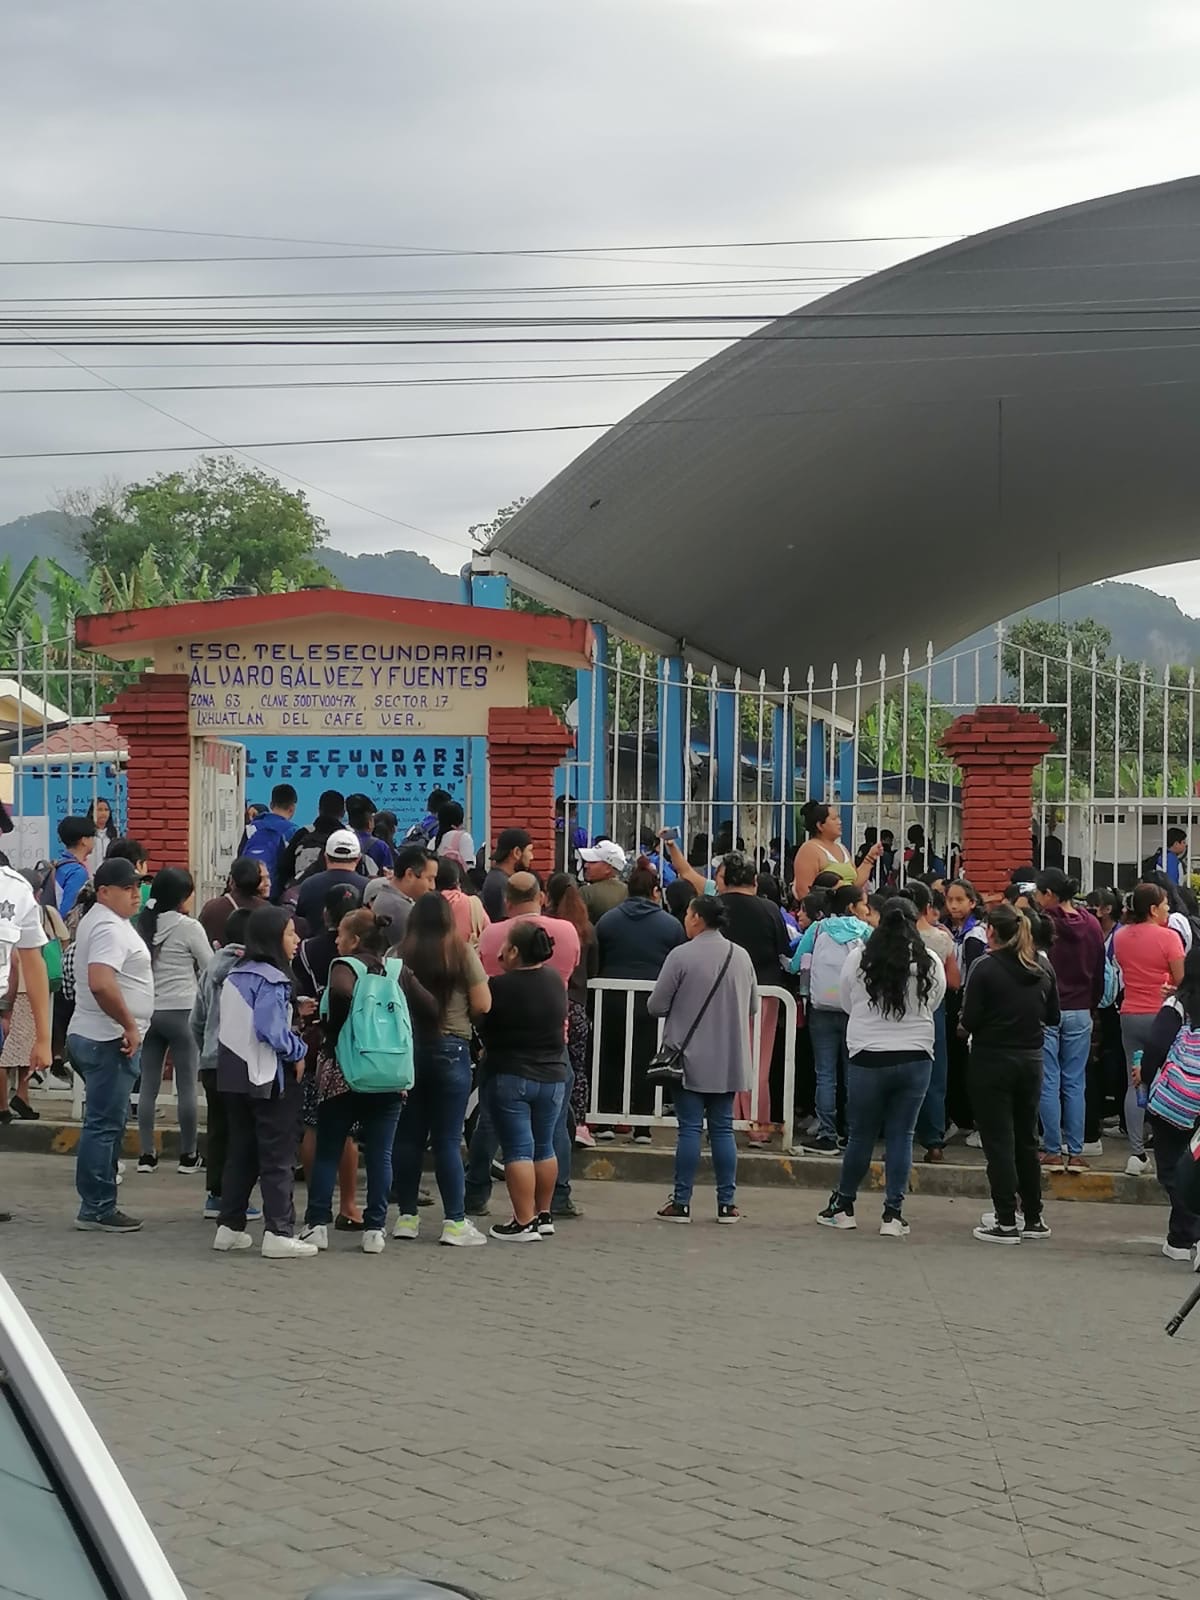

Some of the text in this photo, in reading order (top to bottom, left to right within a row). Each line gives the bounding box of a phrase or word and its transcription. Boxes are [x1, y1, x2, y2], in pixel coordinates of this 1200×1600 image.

[190, 643, 492, 662] ESC. TELESECUNDARIA
[370, 666, 382, 687] Y
[389, 666, 488, 688] FUENTES
[190, 694, 216, 708] ZONA
[261, 694, 289, 708] CLAVE
[374, 694, 428, 708] SECTOR
[435, 695, 449, 708] 17
[282, 712, 309, 726] DEL
[324, 712, 363, 726] CAFE
[381, 713, 421, 726] VER.
